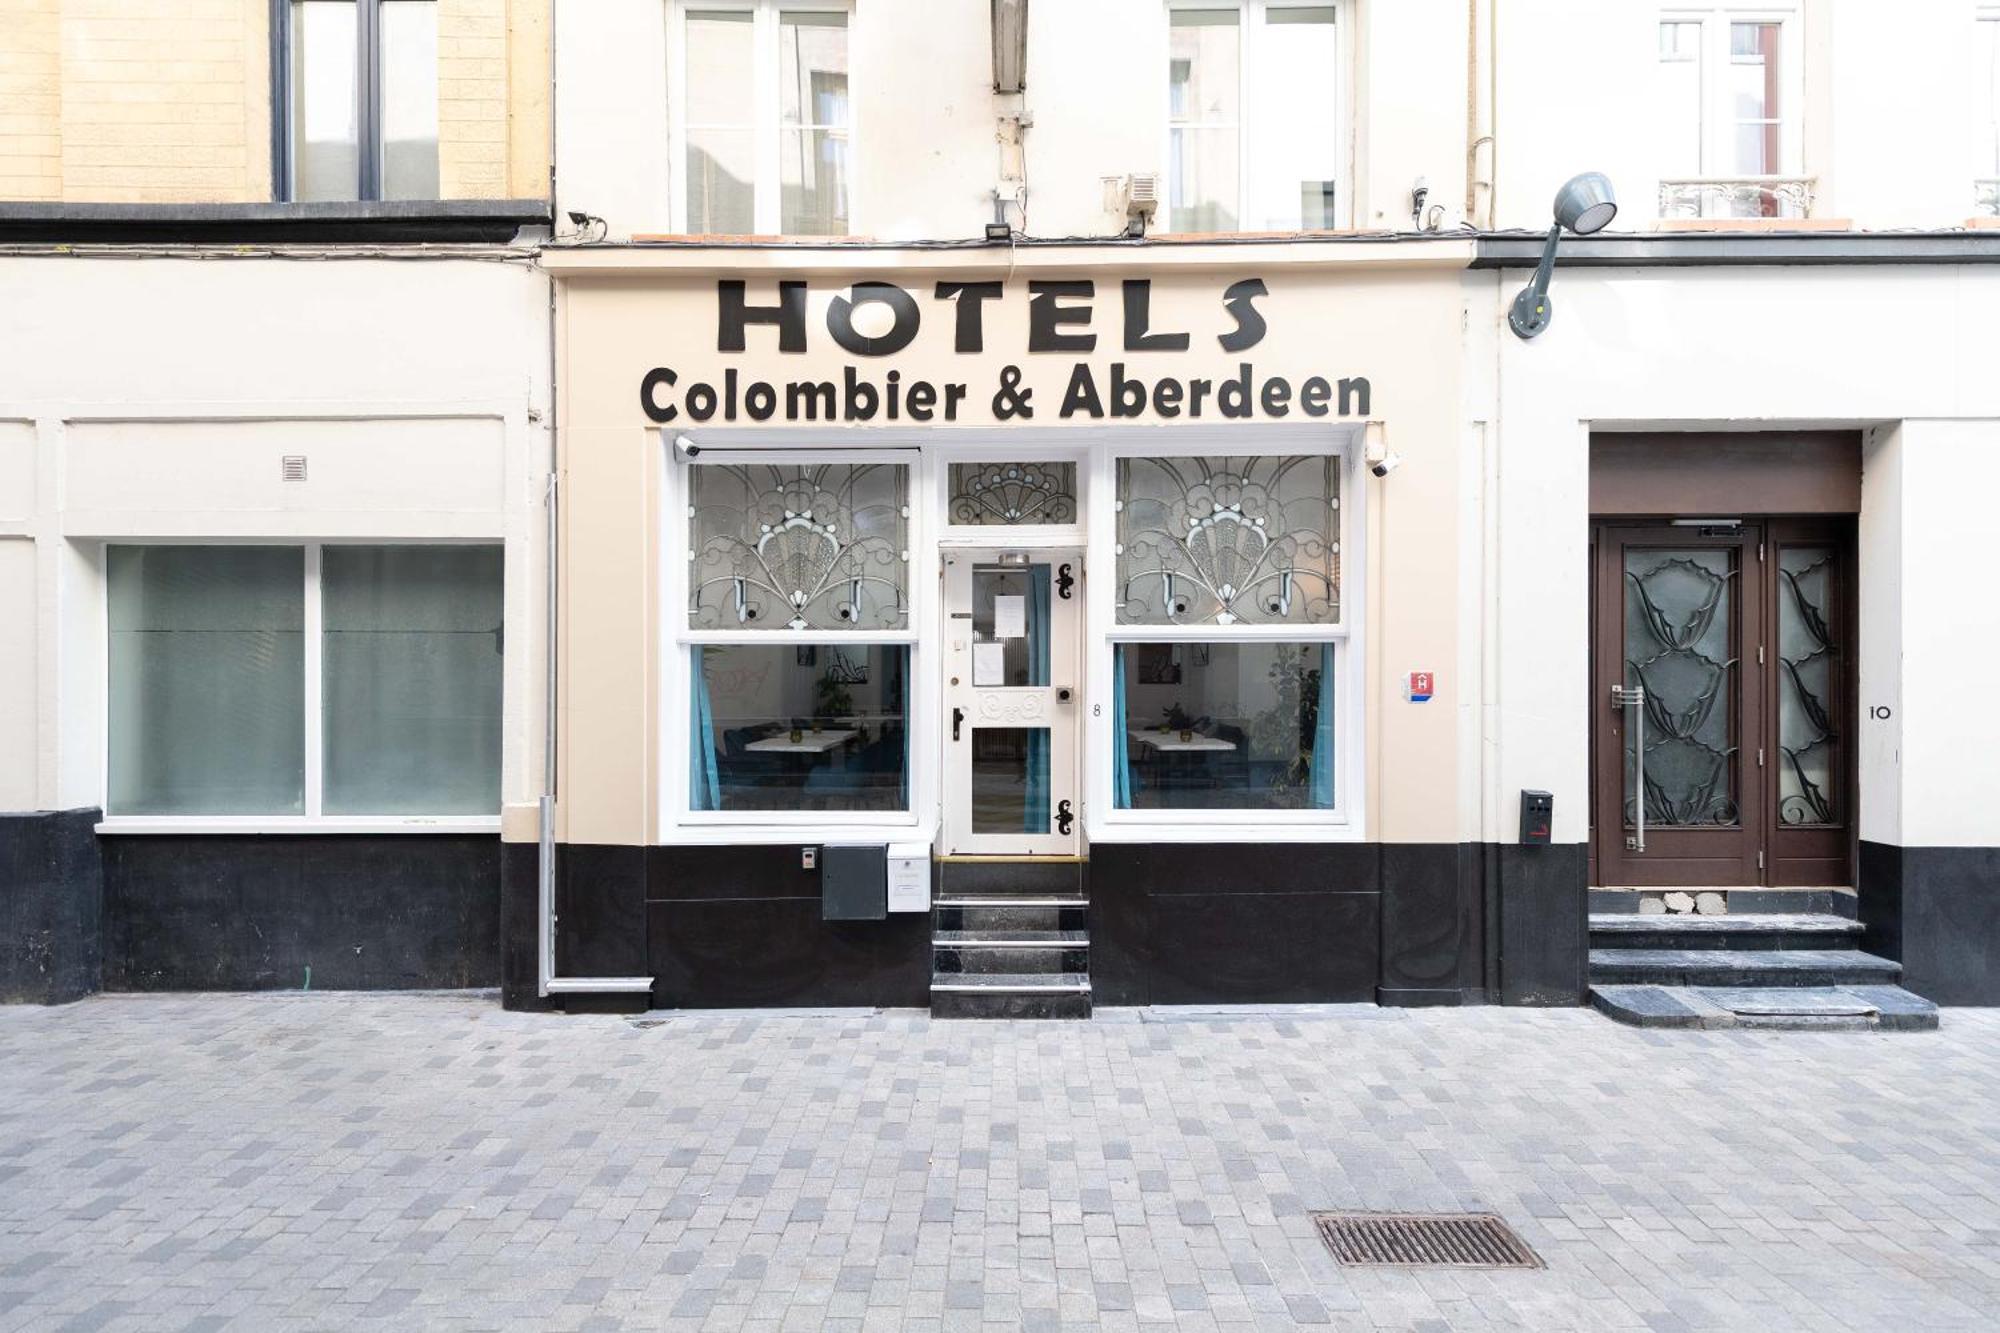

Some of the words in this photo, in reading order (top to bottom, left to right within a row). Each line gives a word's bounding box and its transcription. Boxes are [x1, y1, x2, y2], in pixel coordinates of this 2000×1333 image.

[717, 277, 1268, 357] HOTELS
[640, 366, 967, 423] Colombier
[991, 365, 1034, 421] &
[1059, 362, 1371, 419] Aberdeen
[1094, 703, 1101, 717] 8
[1870, 706, 1891, 720] 10
